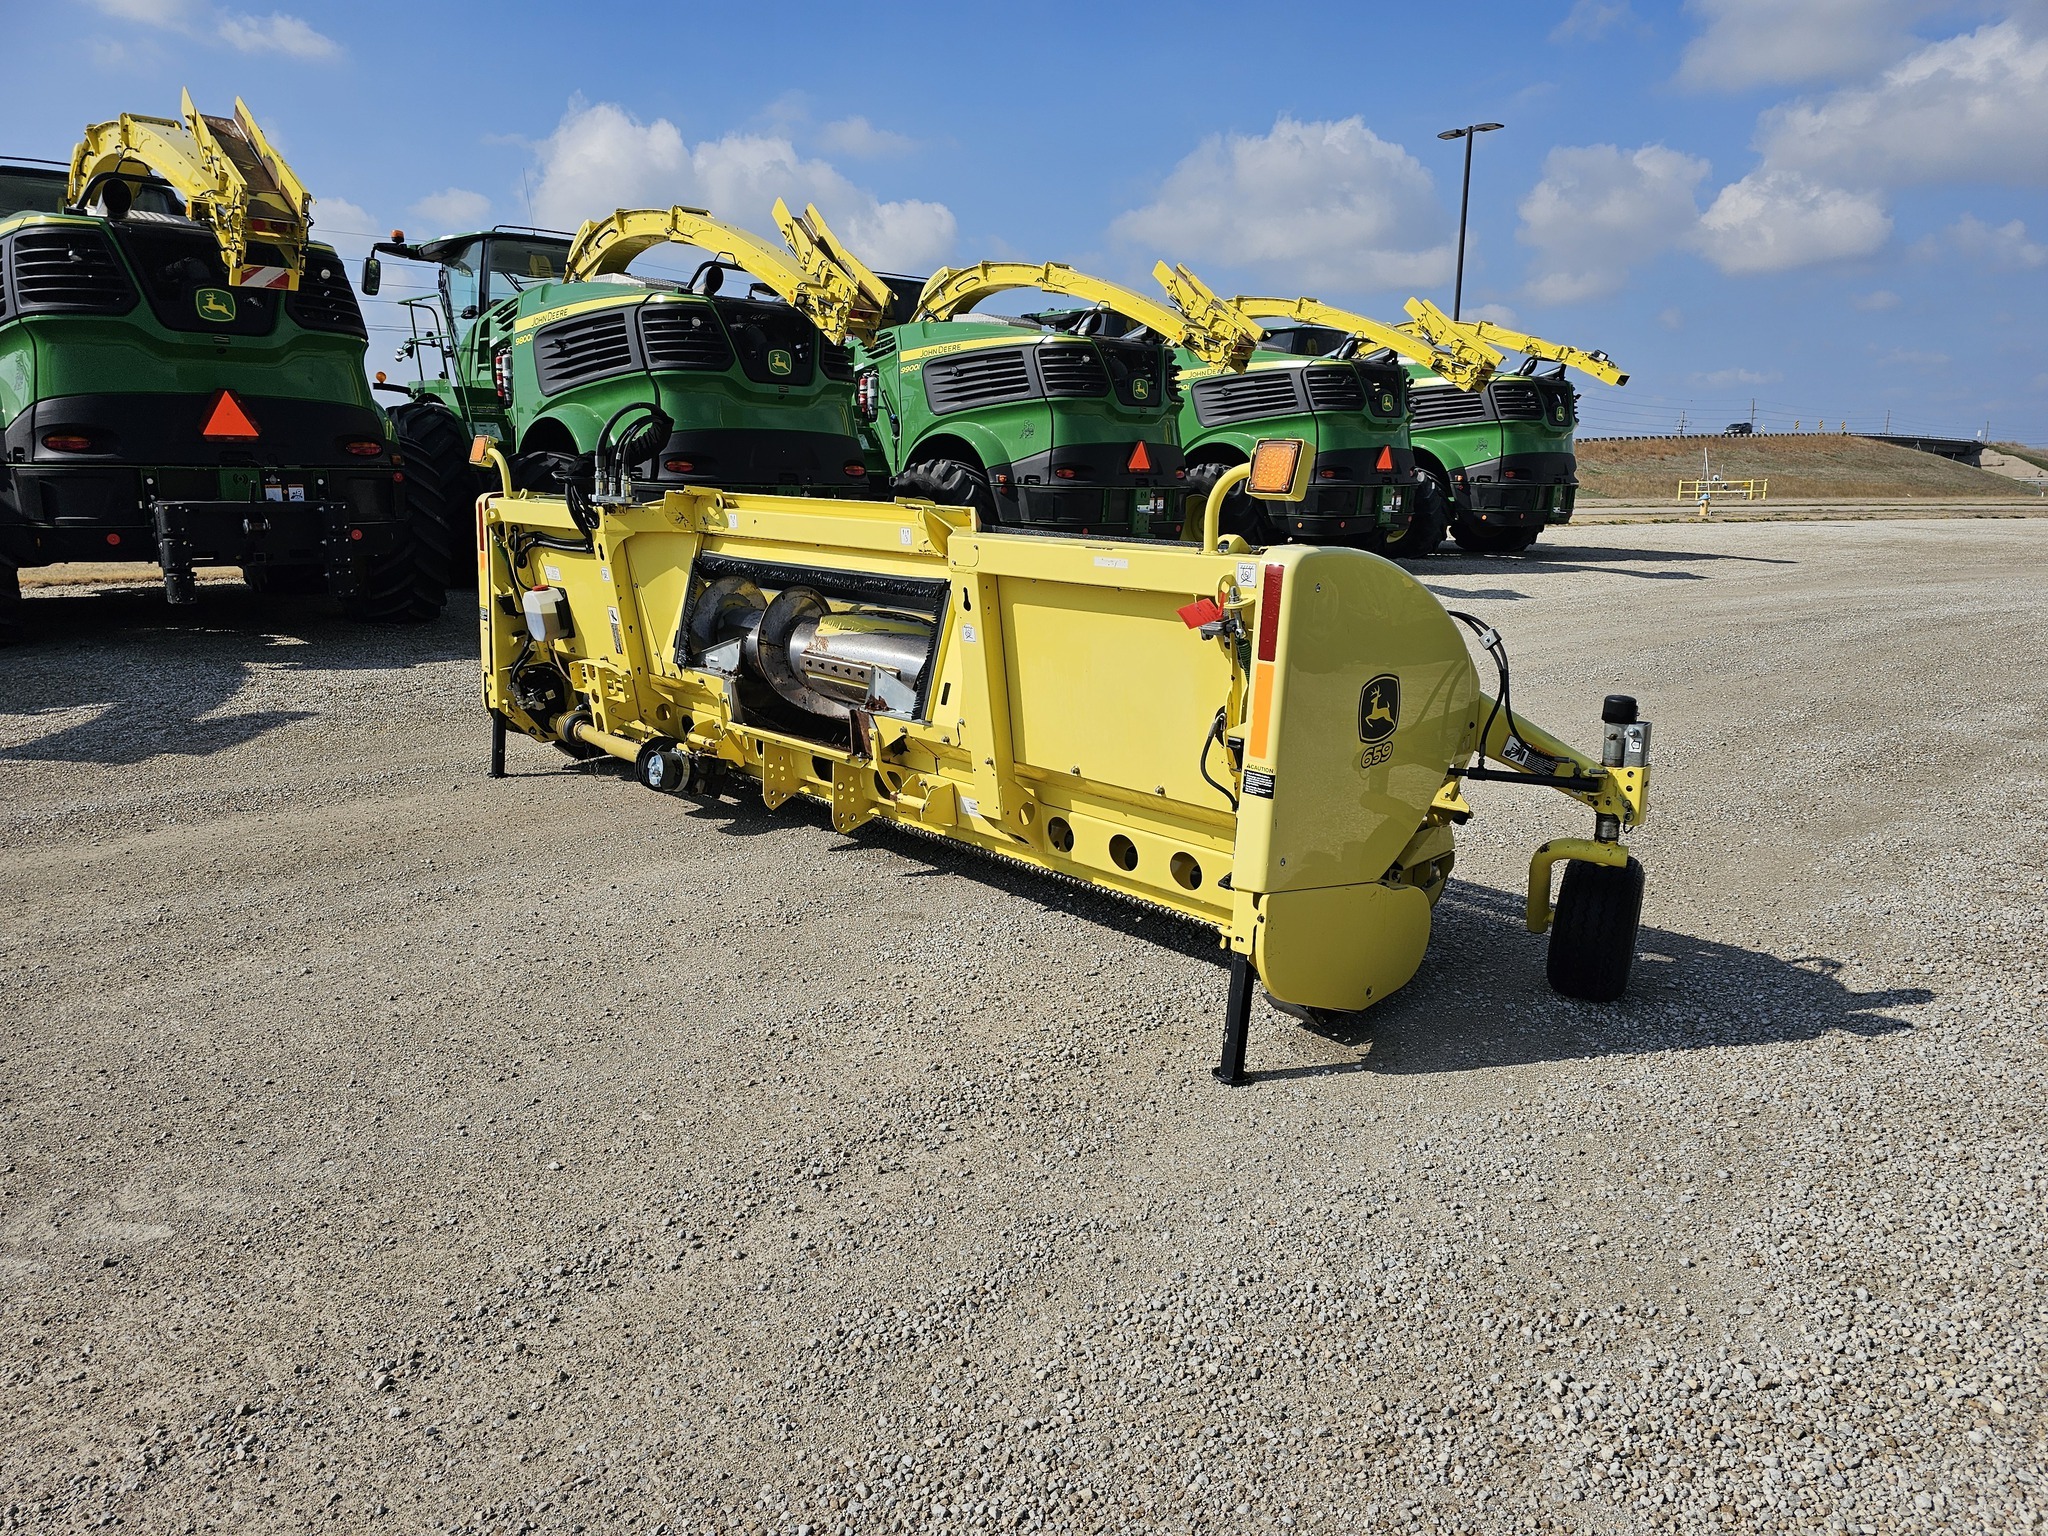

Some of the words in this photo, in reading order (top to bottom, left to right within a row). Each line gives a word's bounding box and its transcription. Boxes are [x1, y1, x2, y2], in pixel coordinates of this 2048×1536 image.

[531, 314, 547, 327] JOHN
[547, 308, 568, 321] DEERE
[920, 348, 938, 358] JOHN
[938, 344, 962, 354] DEERE
[900, 361, 922, 374] 9900i
[1189, 370, 1207, 379] JOHN
[1207, 366, 1230, 376] DEE
[1360, 740, 1394, 769] 659
[1250, 763, 1274, 774] CAUTION
